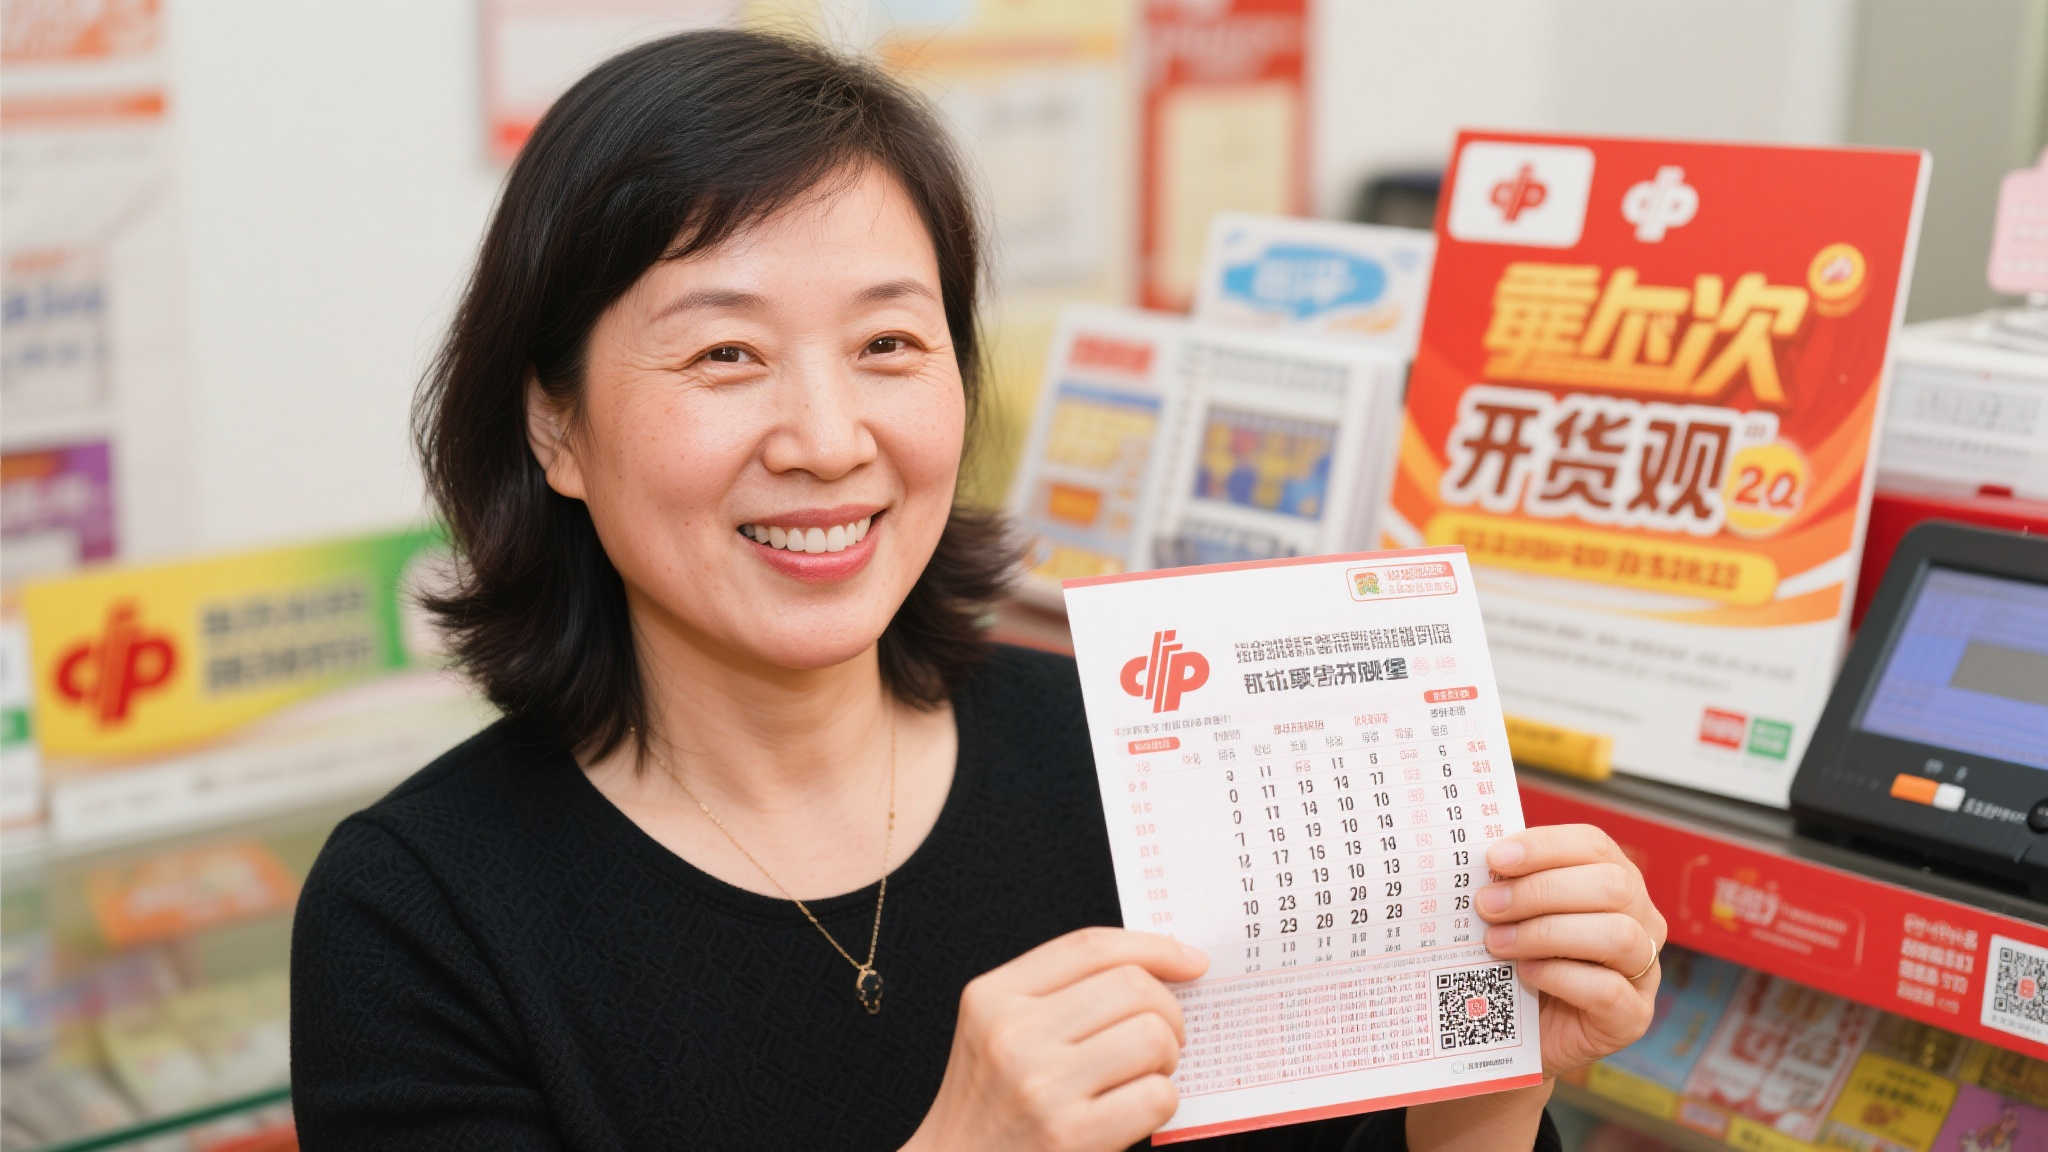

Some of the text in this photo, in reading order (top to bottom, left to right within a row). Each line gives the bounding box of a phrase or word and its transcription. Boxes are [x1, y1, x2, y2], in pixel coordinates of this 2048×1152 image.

[1455, 402, 1732, 520] 开货观
[1337, 796, 1354, 812] 10
[1441, 783, 1458, 800] 10
[1341, 817, 1358, 833] 10
[1449, 828, 1466, 844] 10
[1347, 862, 1365, 880] 10
[1453, 850, 1469, 866] 13
[1242, 899, 1260, 916] 10
[1278, 894, 1297, 912] 23
[1314, 889, 1332, 906] 10
[1385, 880, 1402, 897] 29
